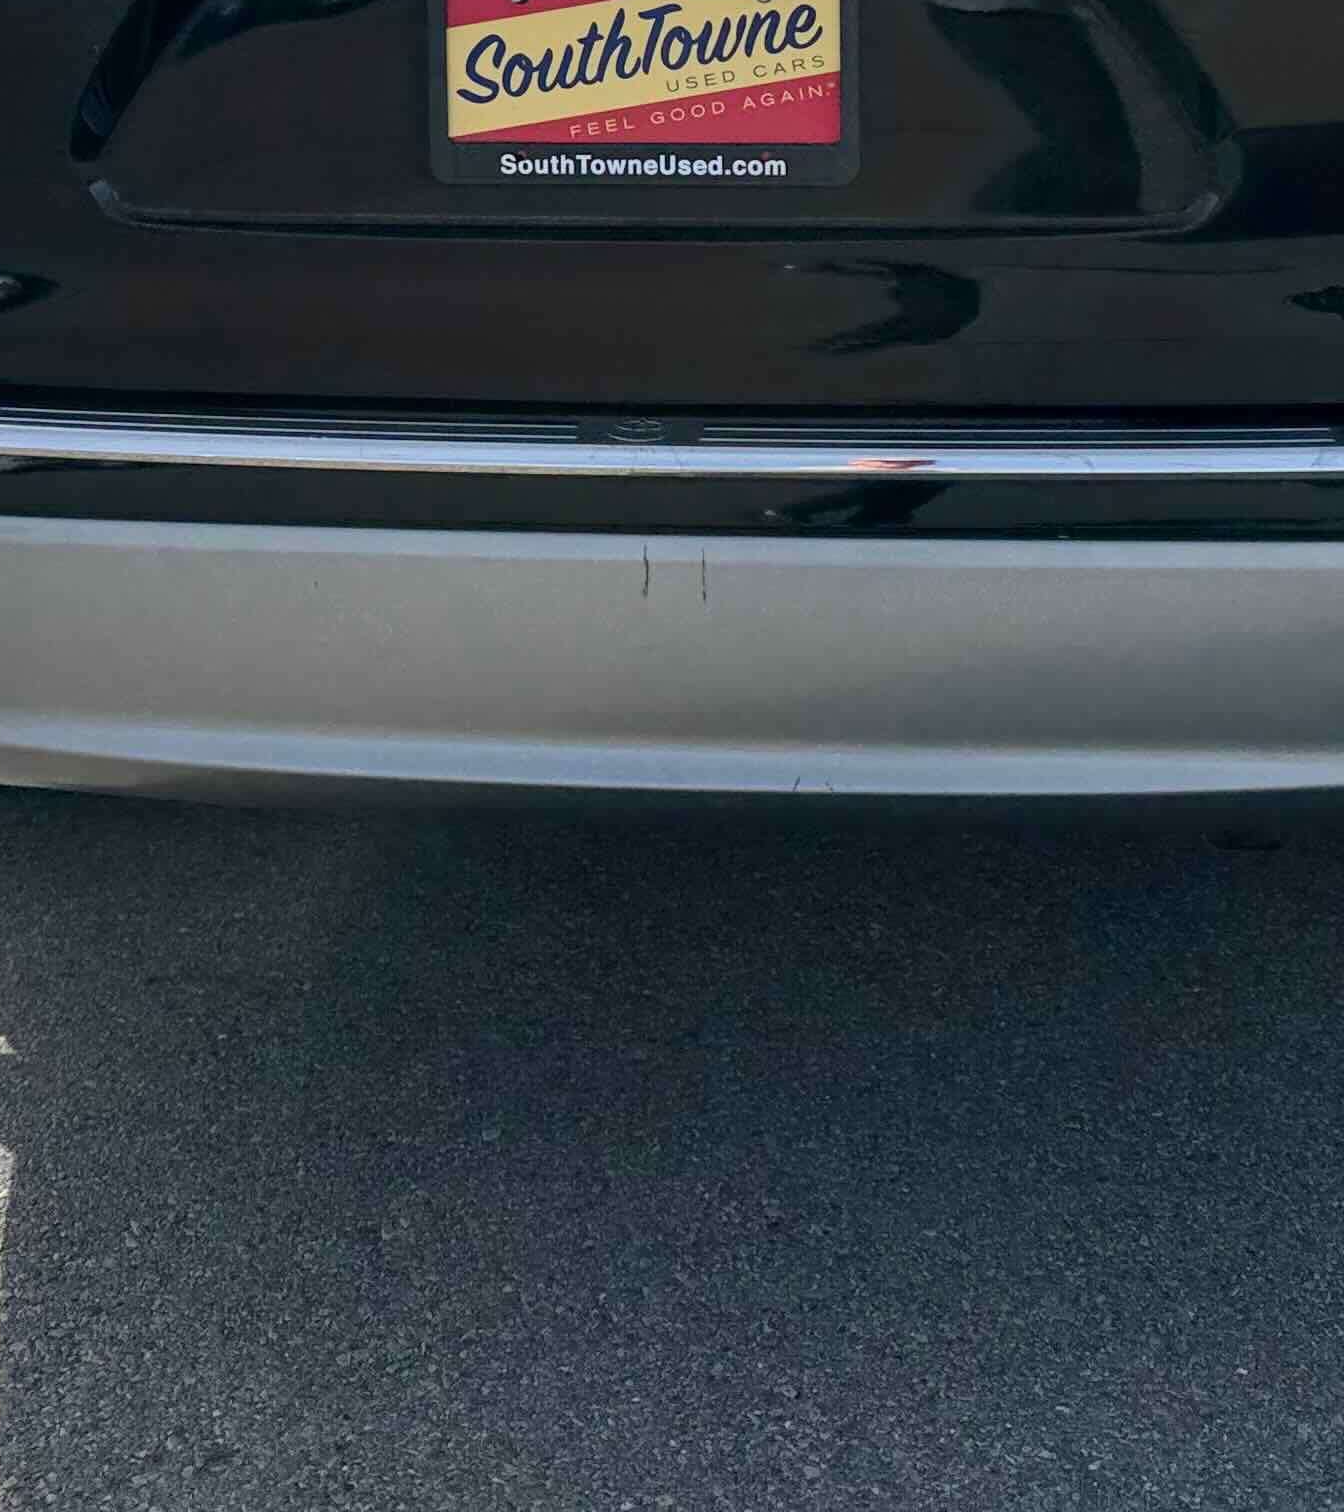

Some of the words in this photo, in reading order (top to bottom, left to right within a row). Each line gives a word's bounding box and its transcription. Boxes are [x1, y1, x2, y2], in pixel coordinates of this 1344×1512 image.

[456, 3, 823, 104] SouthTowne
[665, 69, 736, 93] USED
[752, 55, 825, 79] CARS
[569, 116, 635, 138] FEEL
[649, 101, 726, 125] GOOD
[500, 153, 787, 177] SouthTowneUsed.com
